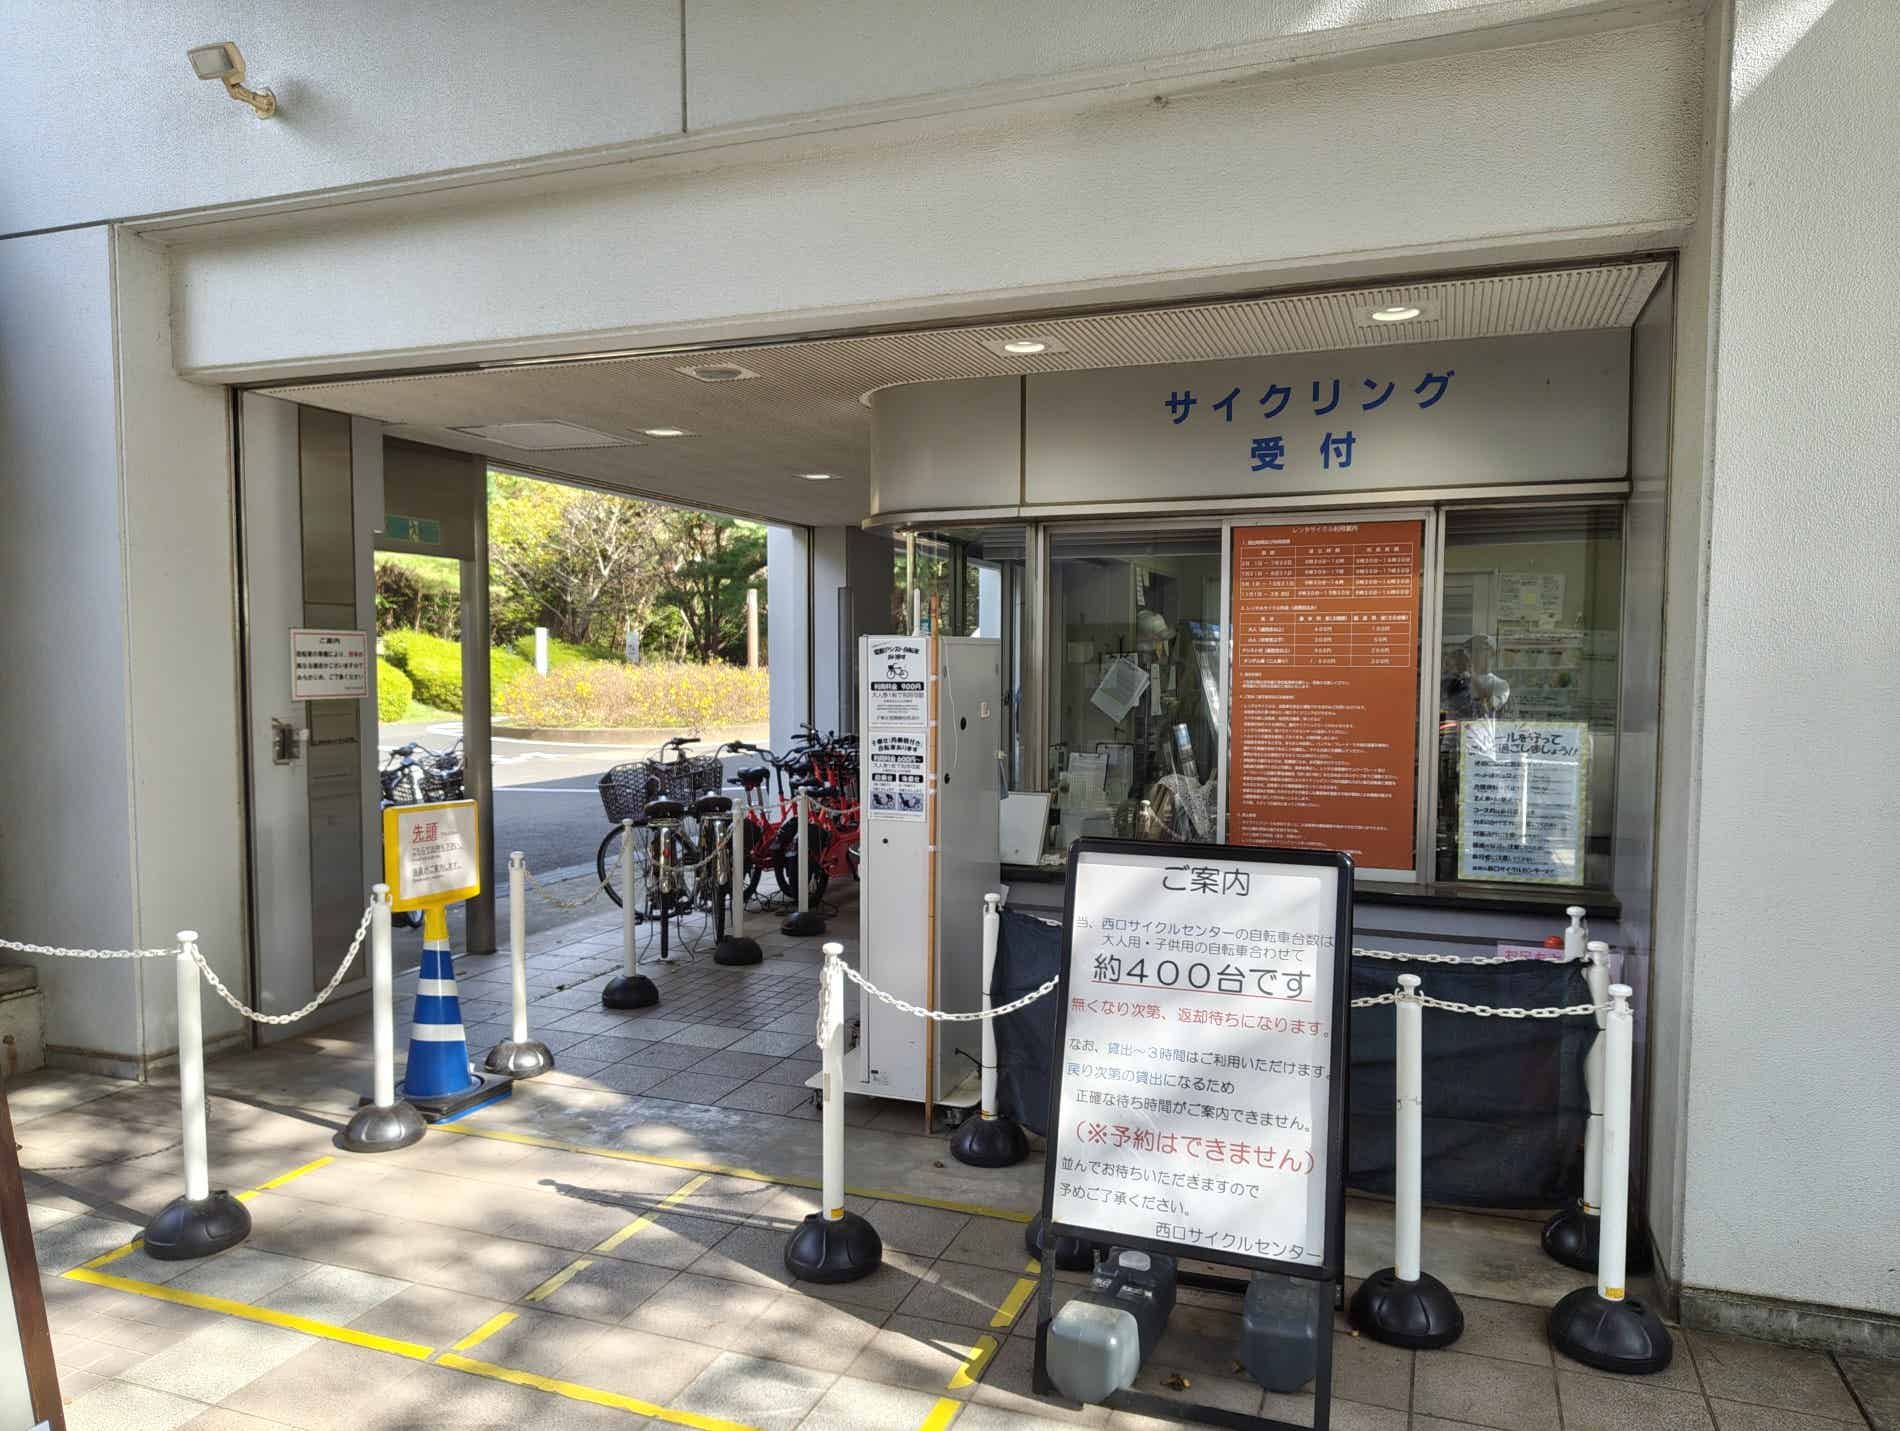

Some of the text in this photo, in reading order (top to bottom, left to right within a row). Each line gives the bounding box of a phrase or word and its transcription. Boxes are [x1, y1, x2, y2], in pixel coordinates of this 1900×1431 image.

[1165, 370, 1456, 425] サイクリング
[1251, 431, 1357, 472] 受付
[412, 822, 438, 844] 先頭
[1162, 865, 1250, 897] ご案内
[1102, 935, 1305, 962] 大人用・子供用の自転車合わせて
[1093, 953, 1312, 999] 約400台です
[1071, 997, 1329, 1038] 無くなり次第、返却待ちになります。
[1066, 1062, 1235, 1096] 戻り次第の貸出になるため
[1075, 1089, 1311, 1132] 正確な待ち時間がご案内できません。
[1075, 1120, 1316, 1175] （※予約はできません）
[1061, 1157, 1260, 1199] 並んでお待ちいただきますので
[1059, 1183, 1190, 1217] 予めご了承ください。
[1155, 1222, 1320, 1260] 西口サイクルセンター
